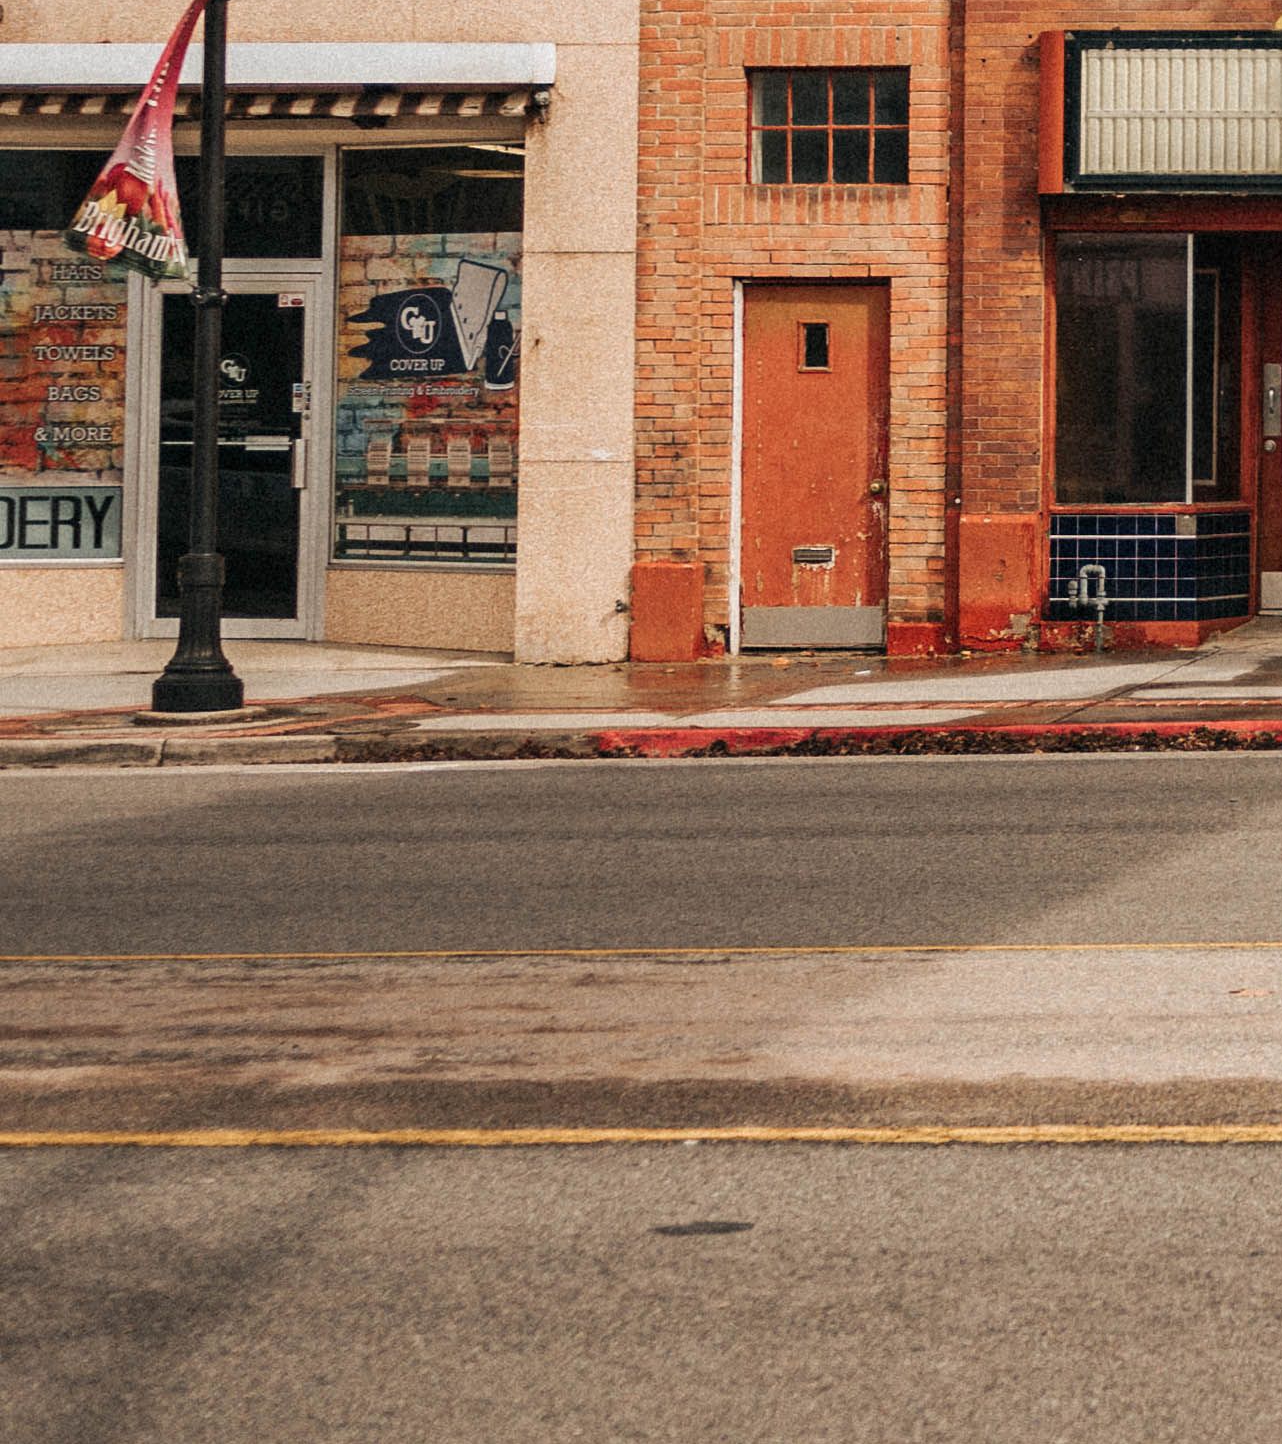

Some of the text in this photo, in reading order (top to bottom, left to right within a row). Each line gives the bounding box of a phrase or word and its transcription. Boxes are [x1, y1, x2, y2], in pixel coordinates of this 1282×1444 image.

[51, 264, 102, 281] HATS
[33, 305, 117, 323] JACKETS
[34, 345, 115, 361] TOWELS
[389, 359, 446, 371] COVER UP
[48, 386, 101, 402] BAGS
[34, 427, 112, 442] & MORE
